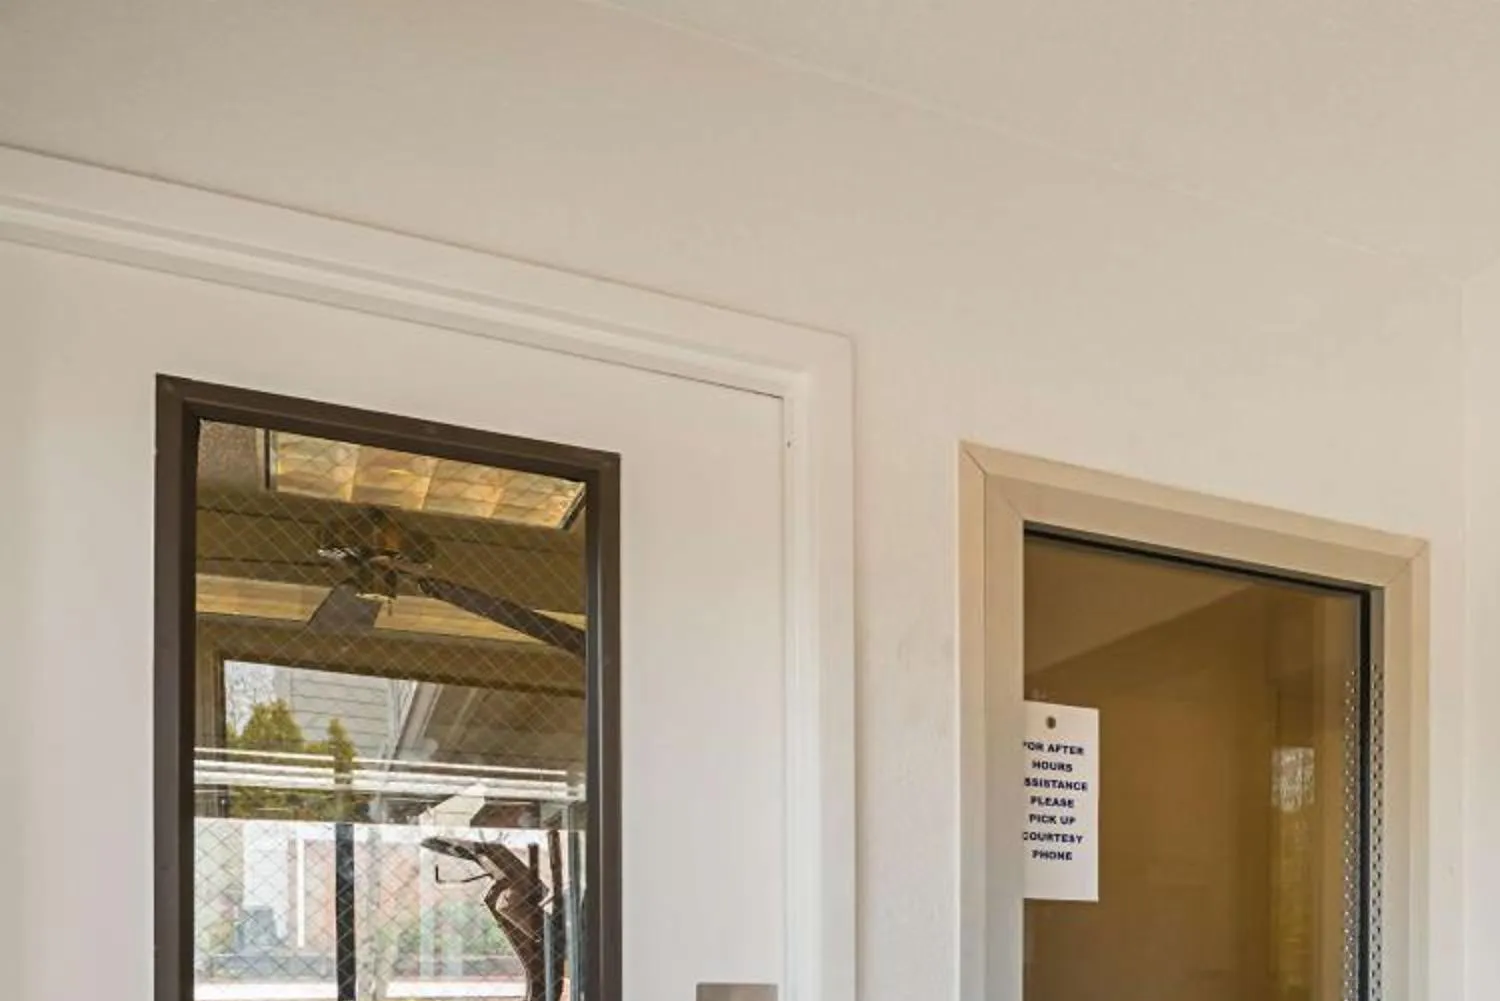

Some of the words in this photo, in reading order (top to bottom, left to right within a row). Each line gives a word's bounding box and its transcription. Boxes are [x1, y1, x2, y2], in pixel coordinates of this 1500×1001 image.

[1047, 743, 1084, 755] AFTER
[1031, 760, 1073, 772] HOURS
[1023, 777, 1088, 791] SSISTANCE
[1030, 795, 1075, 808] PLEASE
[1029, 813, 1057, 825] PICK
[1060, 815, 1076, 825] UP
[1032, 850, 1073, 861] PHONE
